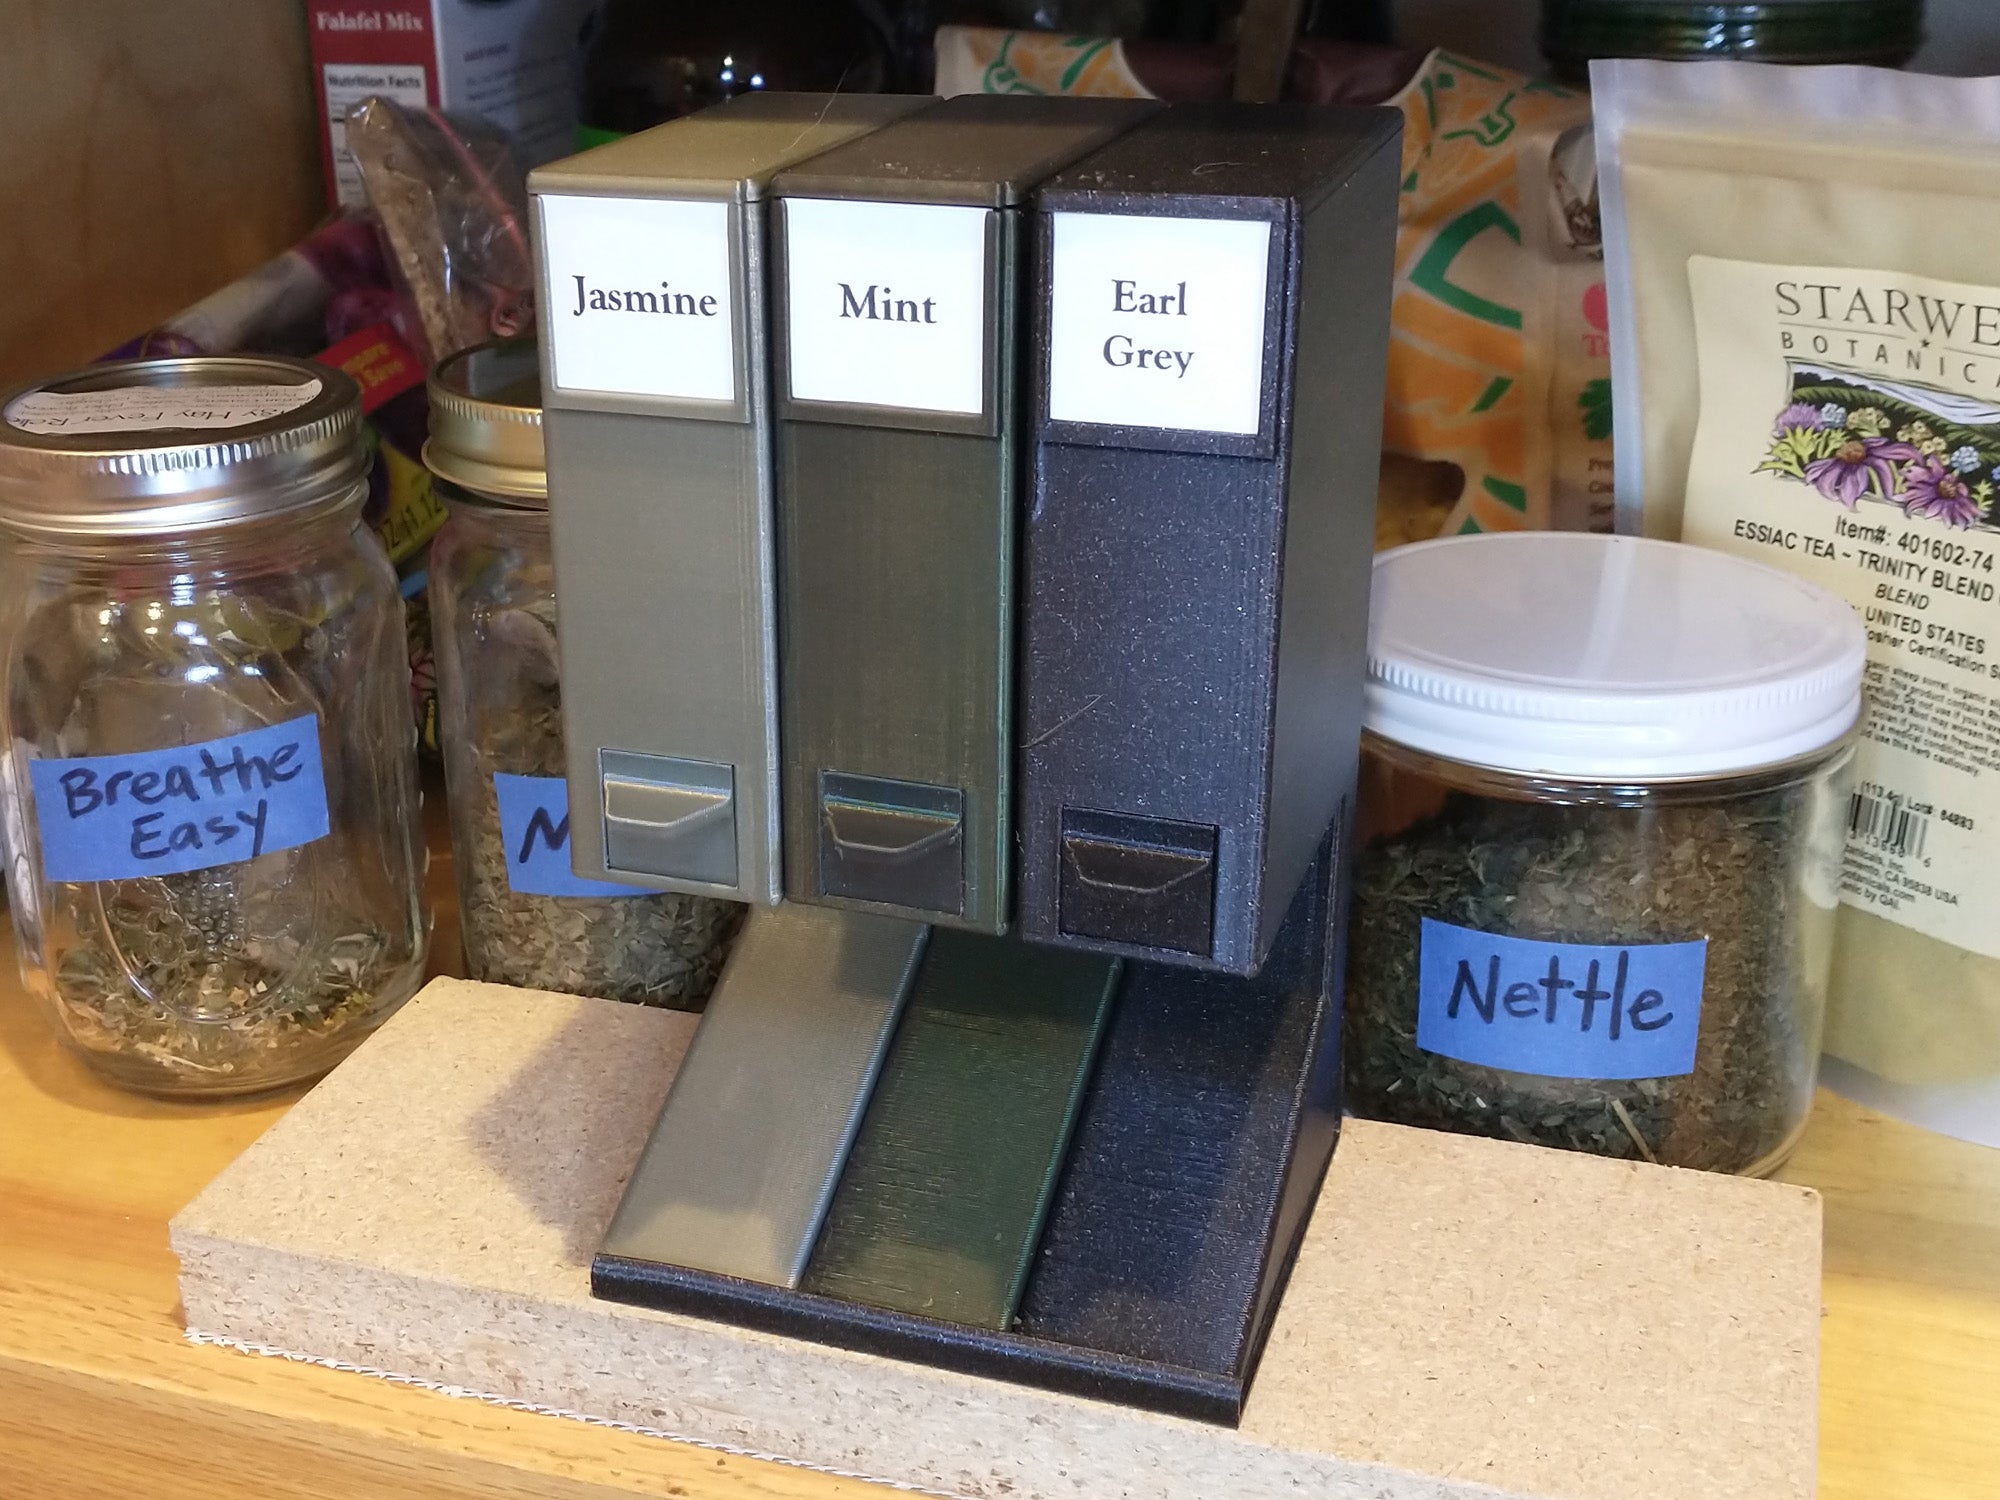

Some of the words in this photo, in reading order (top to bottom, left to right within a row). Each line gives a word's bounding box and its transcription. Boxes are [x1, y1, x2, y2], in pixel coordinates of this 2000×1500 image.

[317, 12, 382, 31] Falafel
[384, 13, 424, 32] Mix
[328, 75, 386, 88] Nutrition
[389, 75, 422, 89] Facts
[571, 275, 718, 318] Jasmine
[838, 282, 938, 325] Mint
[1111, 279, 1188, 317] Earl
[1775, 281, 2000, 347] STARWE
[1103, 335, 1195, 380] Grey
[1781, 331, 2000, 388] BOTANIC
[1733, 519, 1798, 550] ESSIAC
[1803, 536, 1836, 560] TEA
[1858, 550, 1928, 582] TRINITY
[1932, 570, 1994, 602] BLEND
[1835, 514, 1891, 546] Item#:
[1897, 531, 1995, 572] 401602-74
[1875, 582, 1930, 610] BLEND
[1865, 605, 1921, 635] UNITED
[1926, 623, 1985, 654] STATES
[1865, 626, 1903, 648] osher
[1908, 639, 1985, 673] Certification
[59, 741, 303, 819] Breathe
[130, 798, 268, 860] Easy
[1447, 950, 1674, 1041] Nettle
